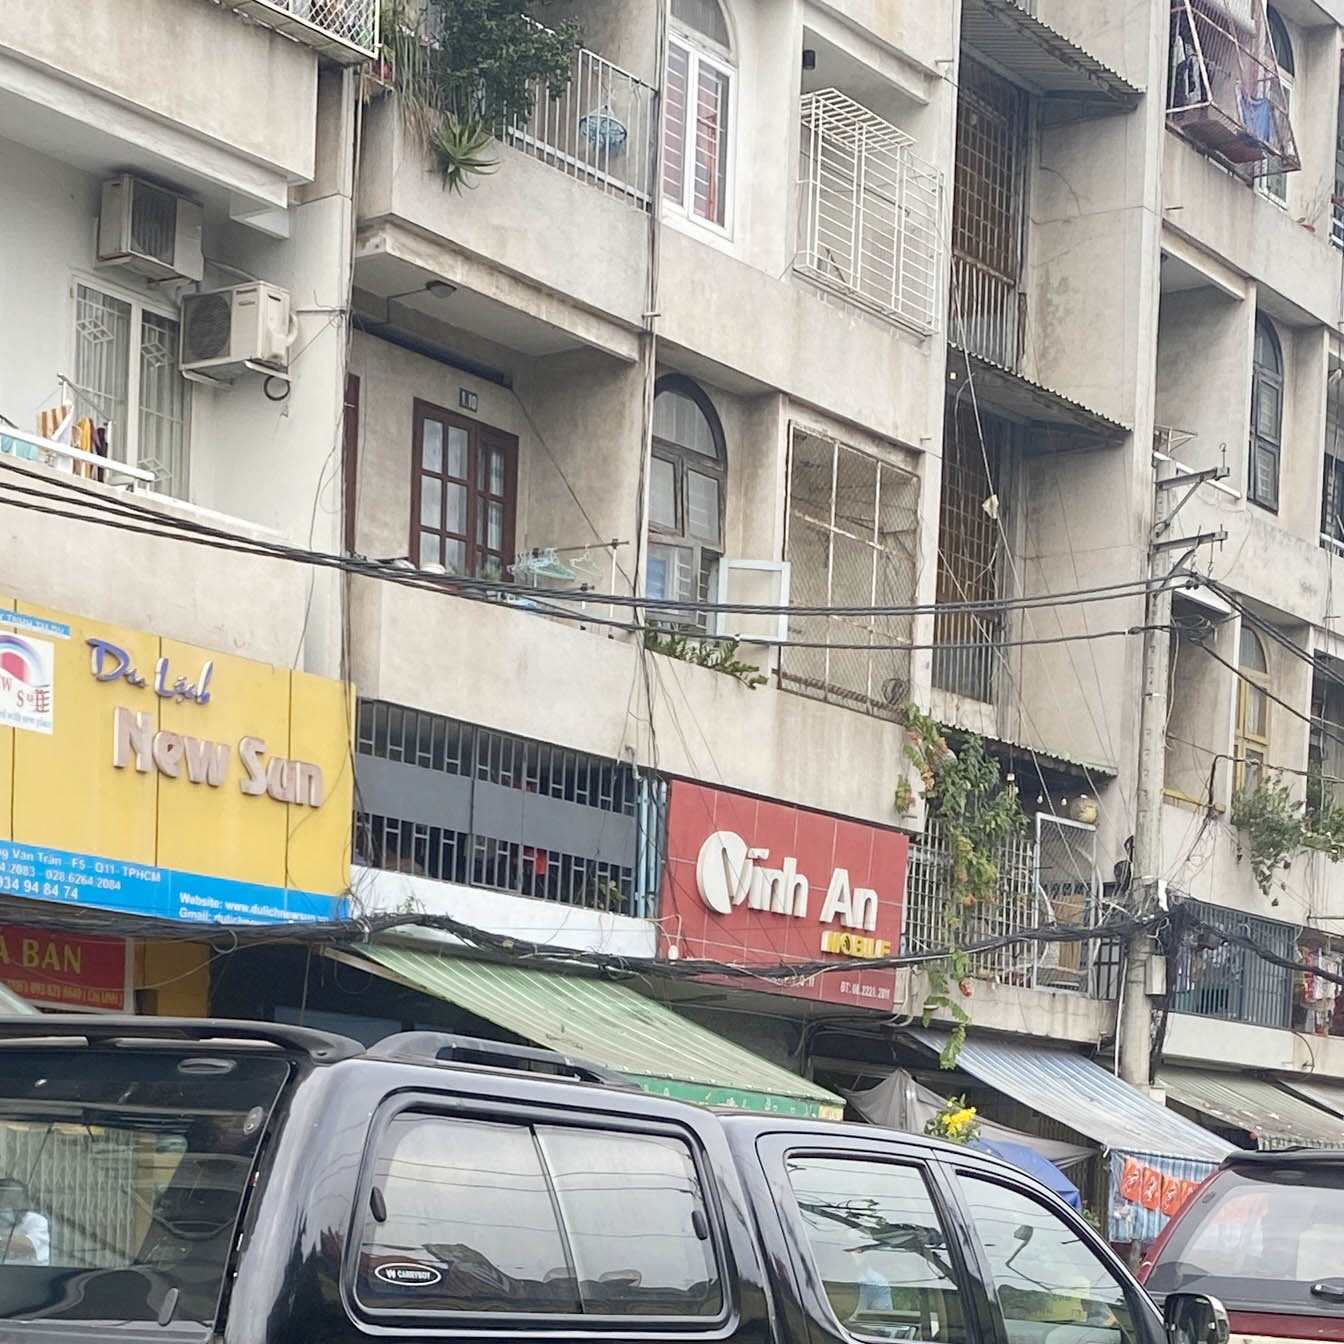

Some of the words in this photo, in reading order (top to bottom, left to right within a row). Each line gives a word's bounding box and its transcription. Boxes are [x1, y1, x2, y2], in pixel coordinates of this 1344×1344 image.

[113, 706, 232, 788] New
[239, 736, 324, 809] Sun
[122, 866, 161, 882] TPHCM
[23, 879, 39, 894] 94
[43, 882, 59, 897] 84
[64, 885, 79, 900] 74
[819, 868, 878, 931] An
[821, 930, 891, 960] MOBILE
